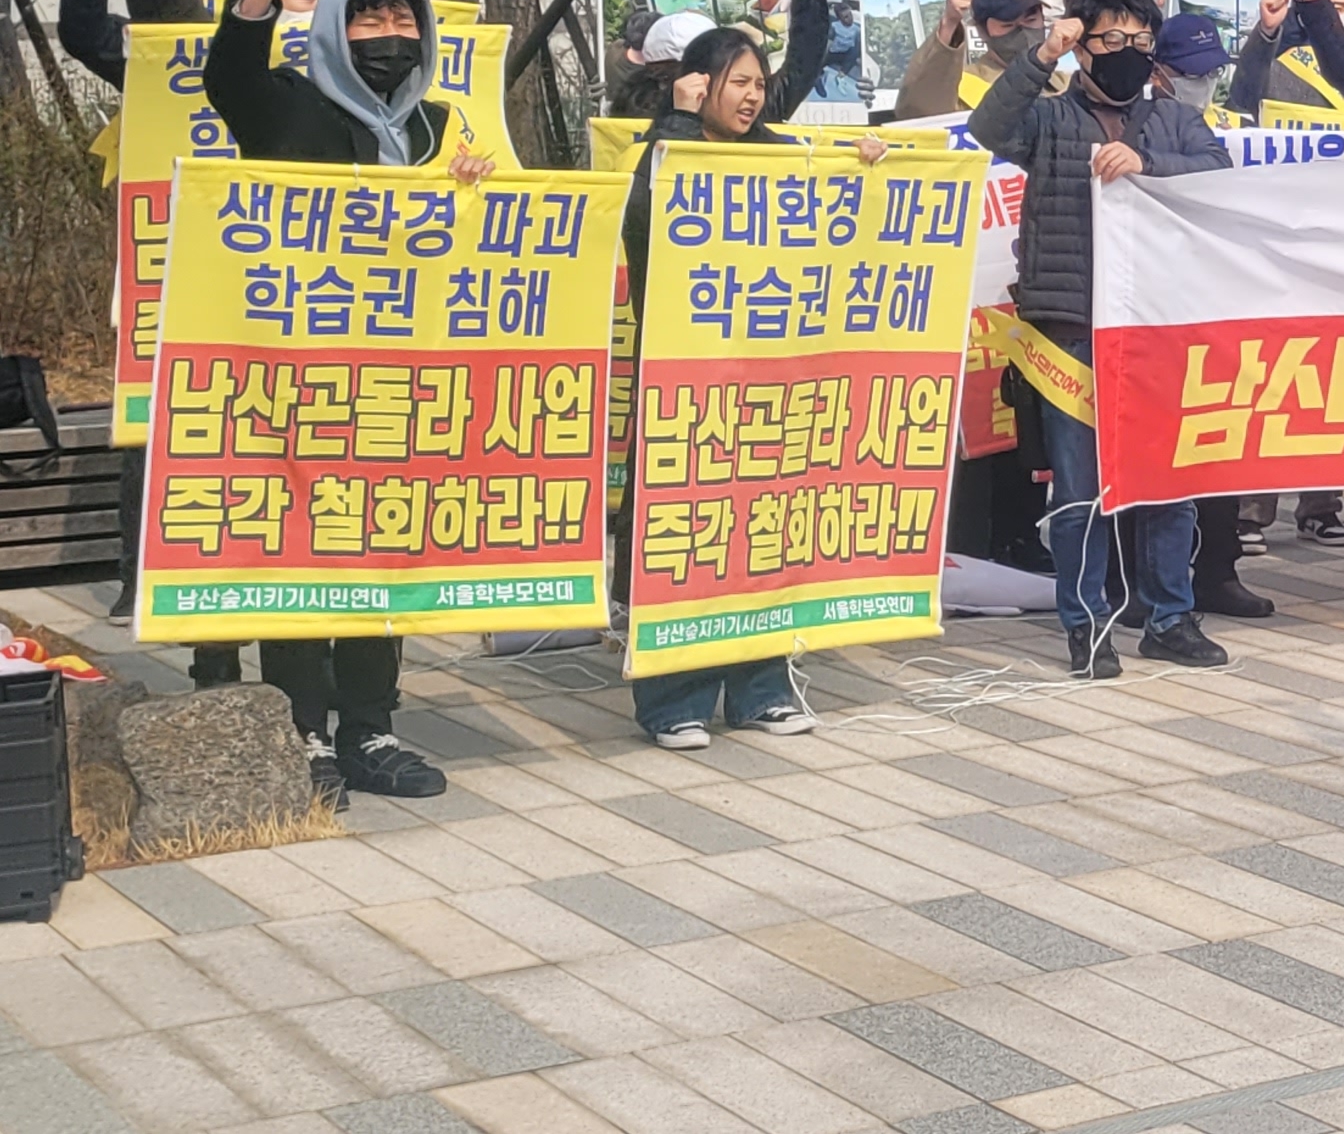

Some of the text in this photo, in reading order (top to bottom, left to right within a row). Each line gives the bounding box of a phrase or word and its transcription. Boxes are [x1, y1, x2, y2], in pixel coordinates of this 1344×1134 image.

[217, 181, 457, 258] 생태환경
[477, 191, 590, 259] 파괴
[664, 171, 972, 248] 생태환경 파괴
[244, 262, 416, 337] 학습권
[445, 266, 551, 337] 침해
[687, 262, 835, 339] 학습권
[843, 260, 934, 334] 침해
[166, 358, 474, 463] 남산곤돌라
[483, 363, 597, 461] 사업
[641, 377, 851, 488] 남산곤돌라
[856, 374, 955, 470] 사업
[160, 474, 593, 556] 즉각 철회하라!!
[641, 484, 939, 584] 즉각 철회하라!!
[176, 579, 575, 610] 남산숲지키기시민연대 서울학부모연대
[655, 596, 915, 646] 남산숲지키기시민연대 서울학부모연대
